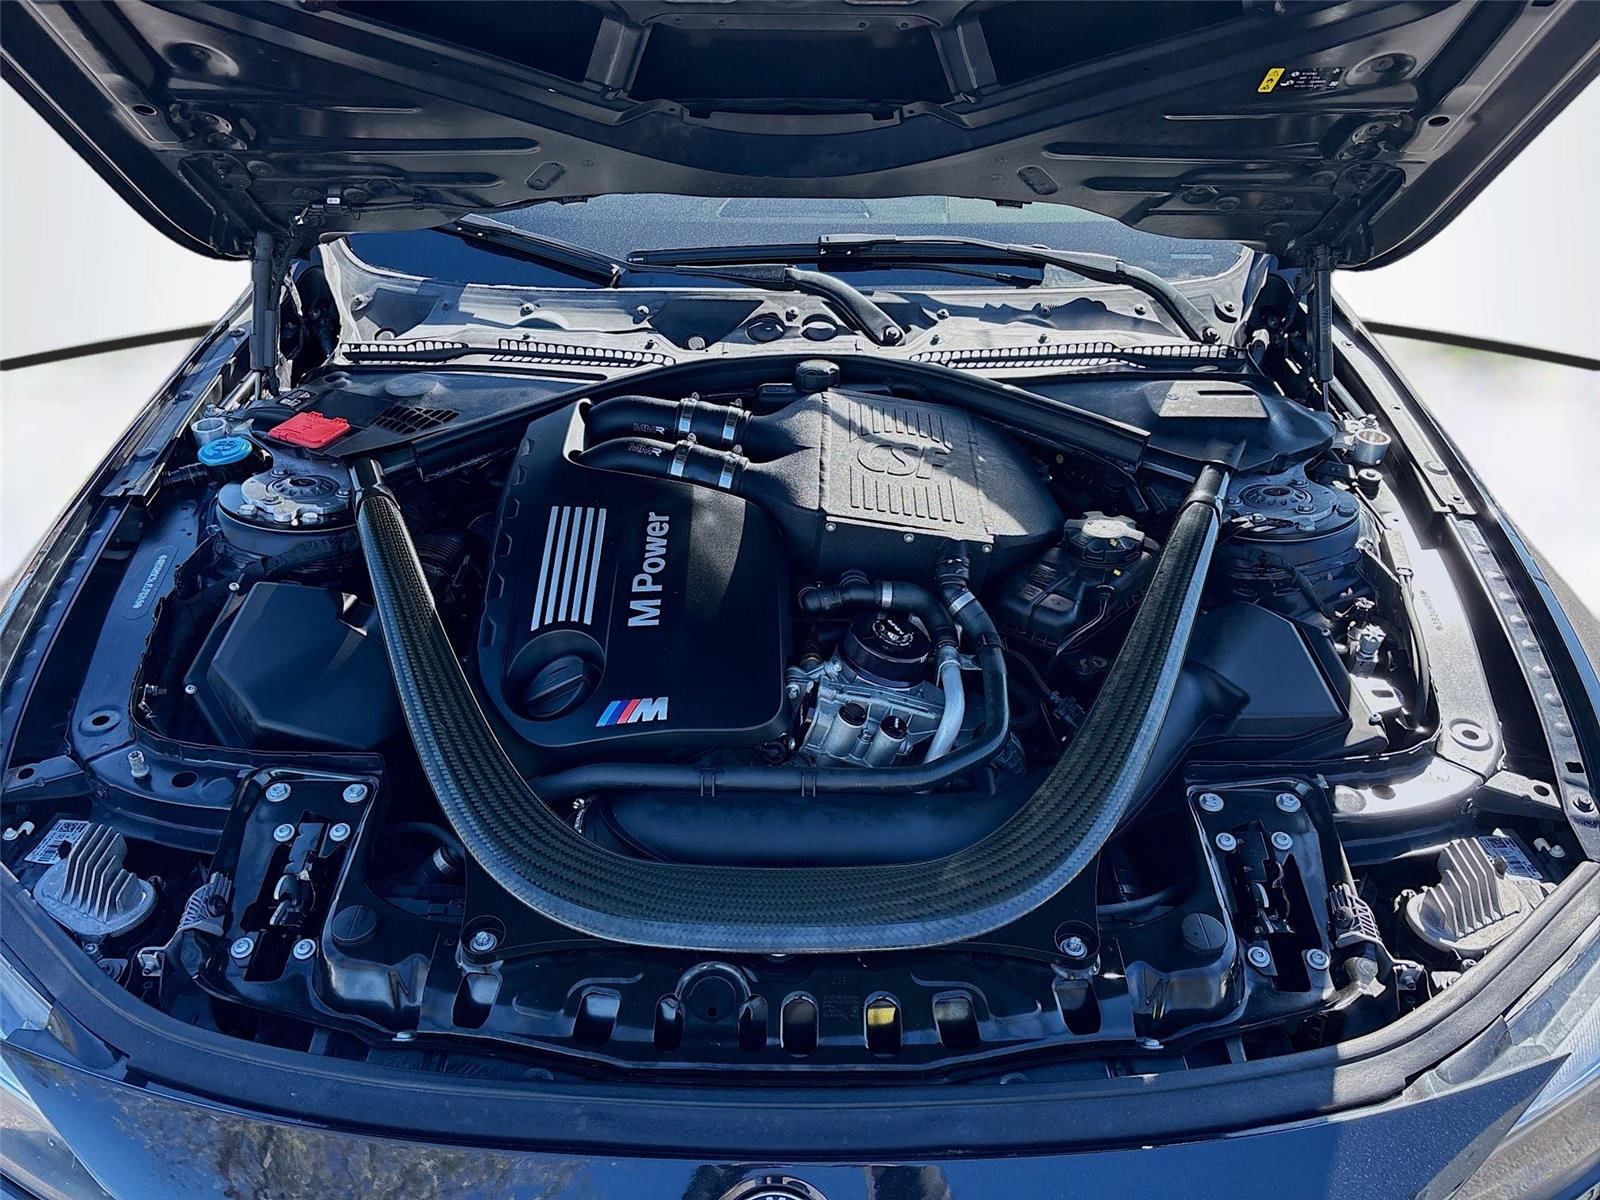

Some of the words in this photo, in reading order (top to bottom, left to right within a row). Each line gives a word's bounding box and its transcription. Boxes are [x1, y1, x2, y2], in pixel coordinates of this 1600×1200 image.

[857, 444, 951, 479] CSF
[631, 512, 670, 593] Power
[628, 599, 662, 627] M
